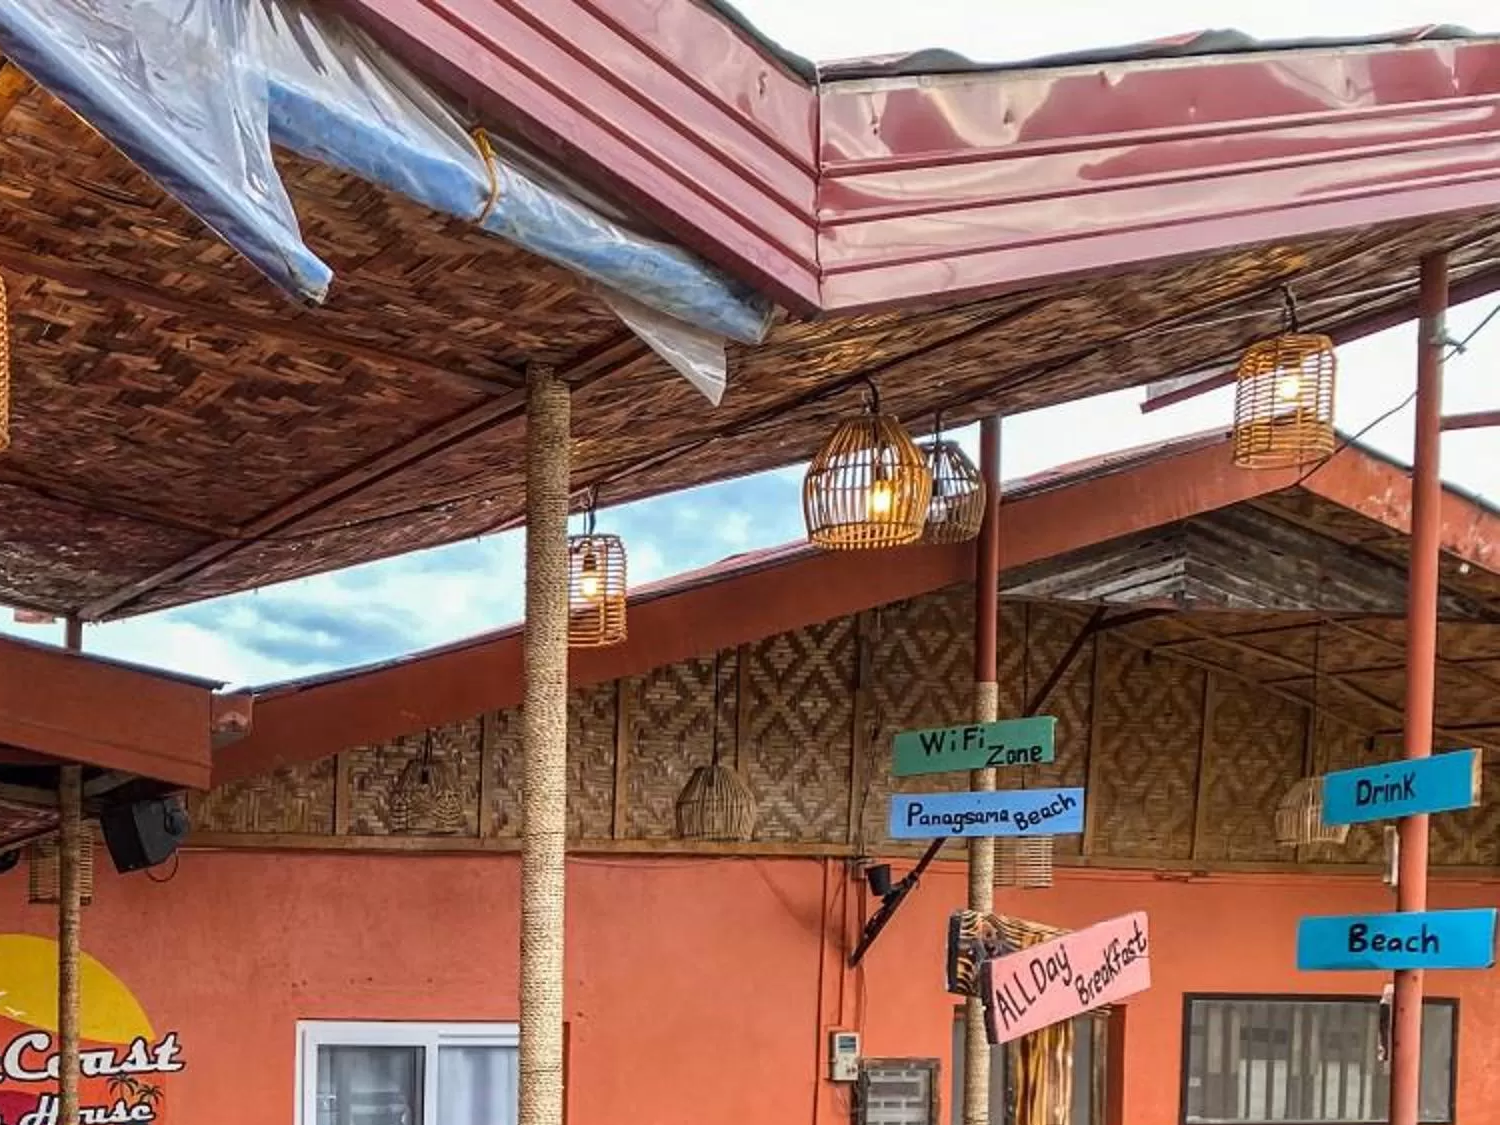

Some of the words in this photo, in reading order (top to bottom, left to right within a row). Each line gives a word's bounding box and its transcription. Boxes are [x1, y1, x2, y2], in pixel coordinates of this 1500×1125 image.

[920, 727, 985, 756] WiFi
[985, 744, 1043, 766] Zone
[907, 802, 1009, 834] Panagsama
[1013, 793, 1077, 831] Beach
[1349, 923, 1440, 954] Beach
[1030, 943, 1073, 993] Day
